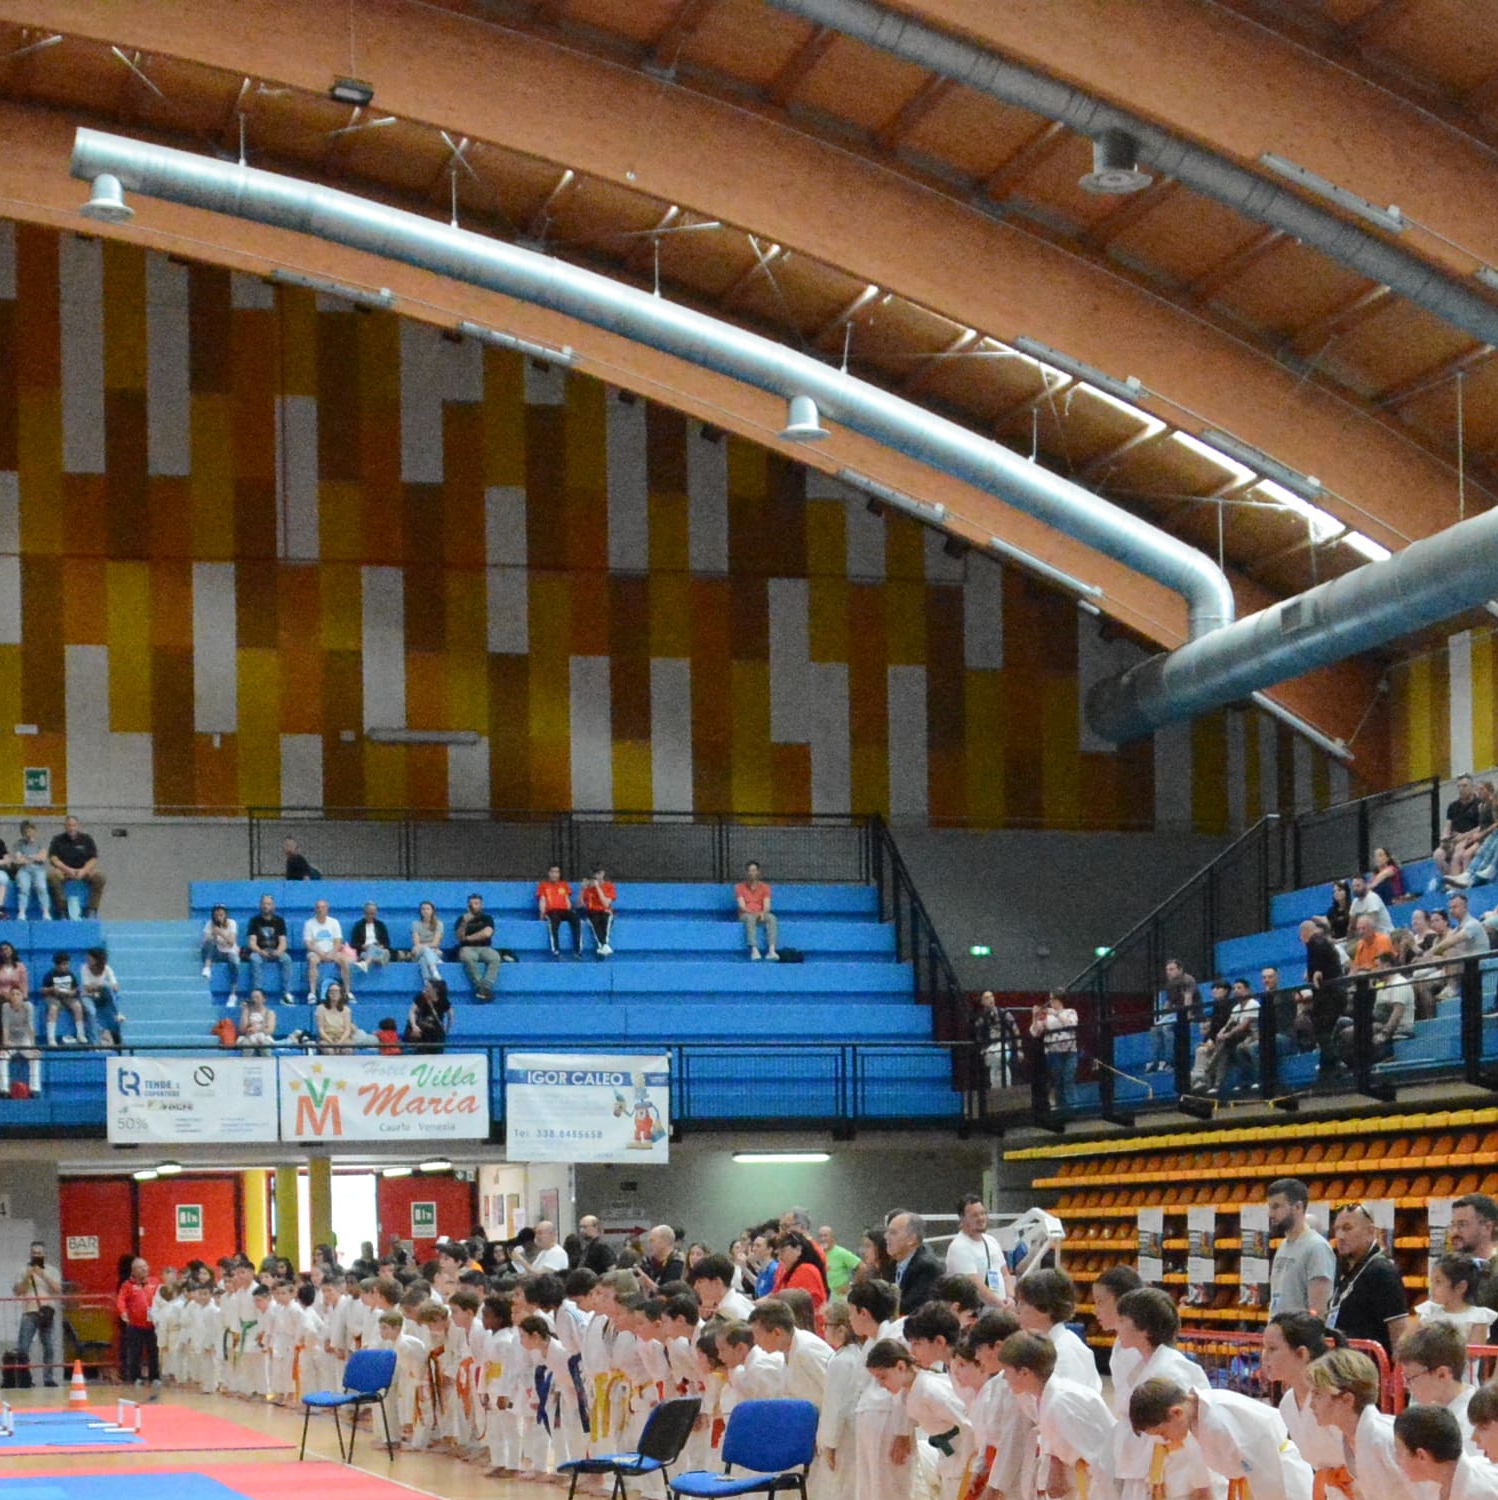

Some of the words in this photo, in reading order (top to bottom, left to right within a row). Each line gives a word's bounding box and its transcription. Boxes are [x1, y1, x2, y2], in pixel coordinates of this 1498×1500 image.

[410, 1064, 477, 1088] Villa
[527, 1071, 568, 1085] IGOR
[571, 1072, 624, 1086] CALEO
[357, 1083, 480, 1118] Maria
[117, 1117, 148, 1131] 50%
[418, 1121, 456, 1132] Venezia
[68, 1237, 97, 1249] BAR
